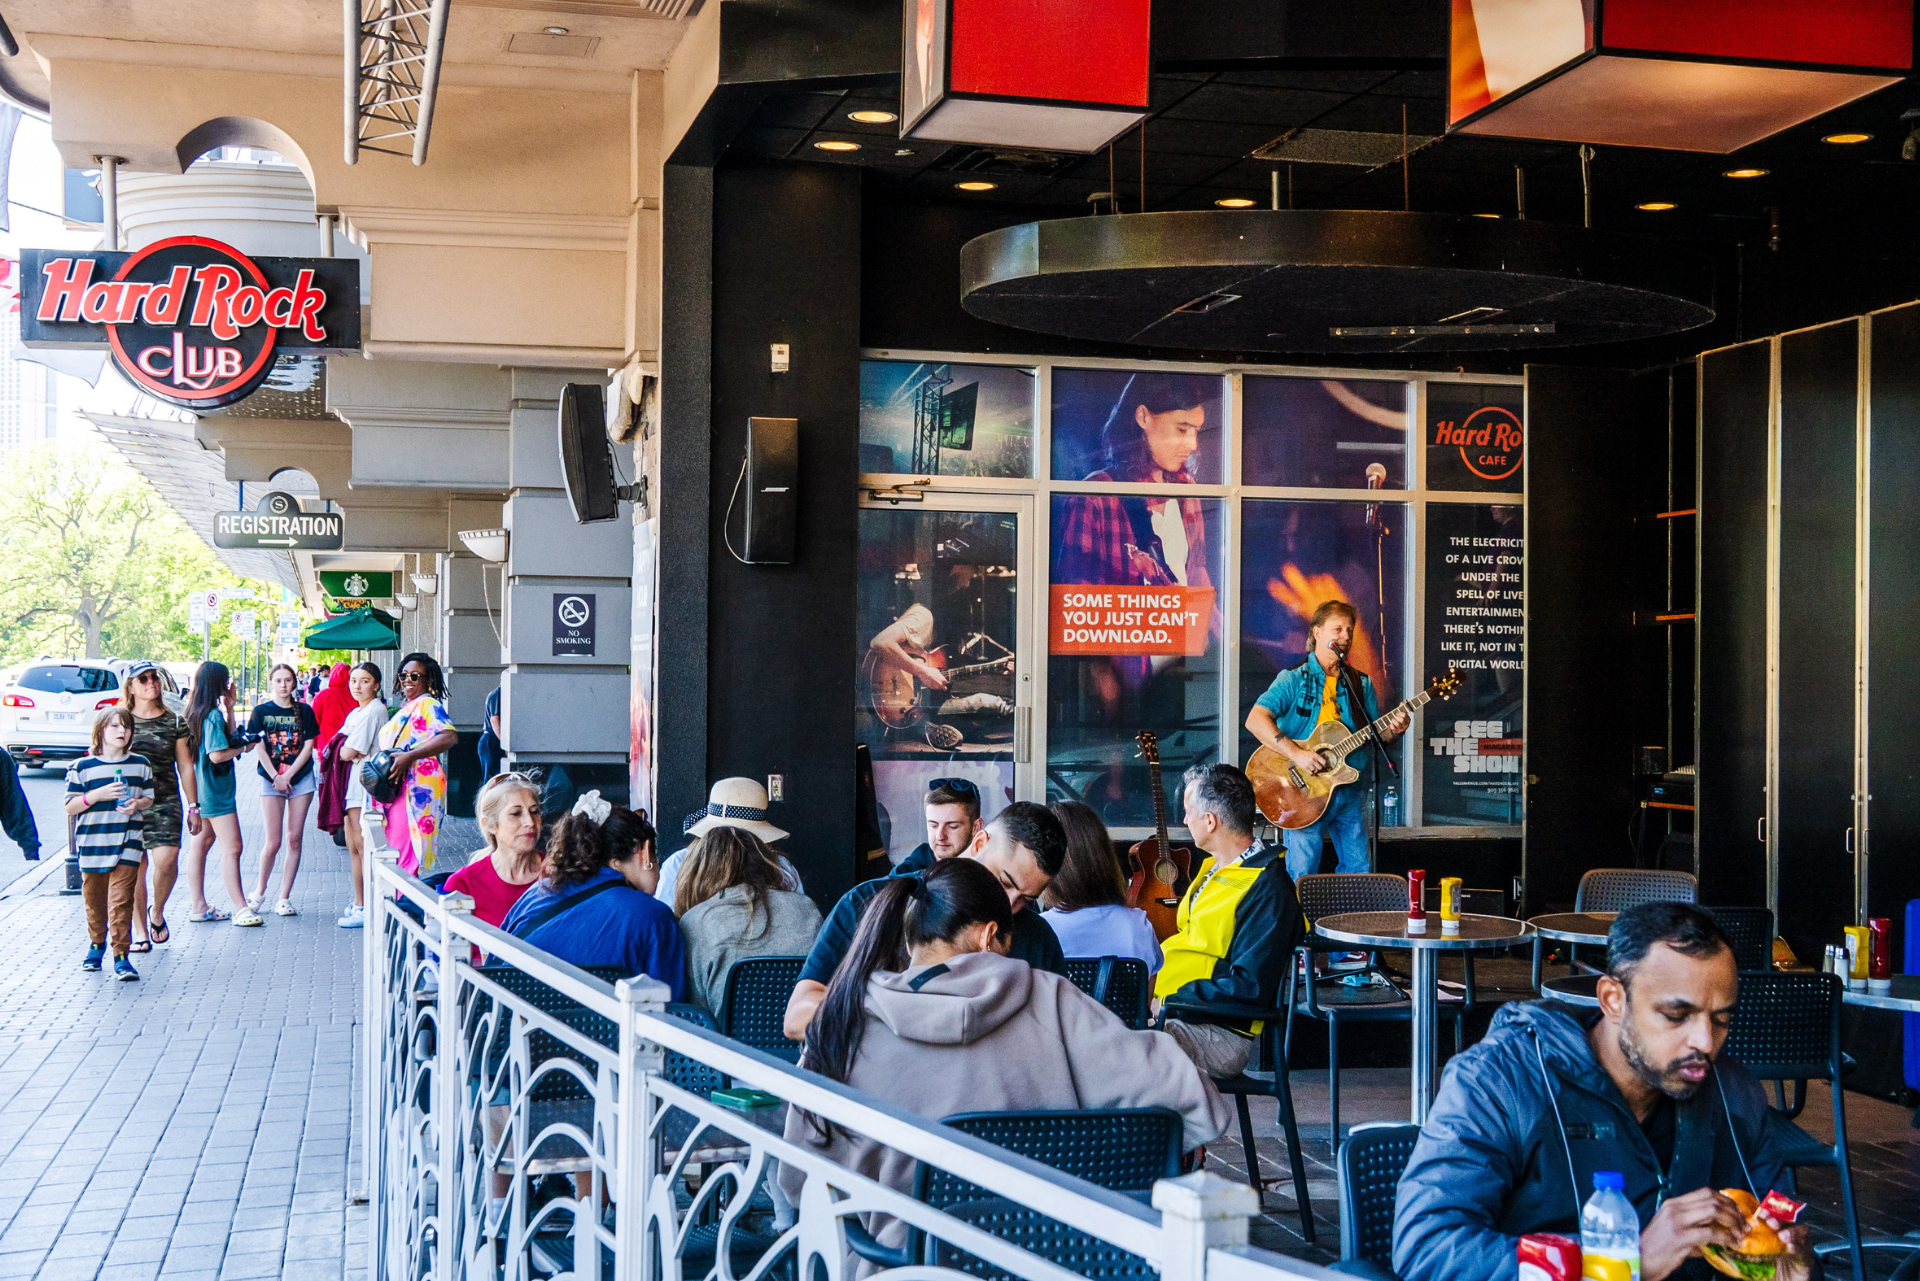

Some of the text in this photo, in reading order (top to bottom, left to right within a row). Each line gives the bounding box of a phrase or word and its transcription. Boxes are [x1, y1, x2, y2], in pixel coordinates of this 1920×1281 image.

[36, 258, 328, 343] Hard Rock
[137, 331, 244, 390] CLUB
[1435, 421, 1493, 446] Hard
[1478, 455, 1507, 466] CAFE
[218, 515, 339, 536] REGISTRATION
[1450, 537, 1470, 546] THE
[1445, 554, 1459, 564] OF
[1461, 555, 1470, 564] A
[1472, 555, 1493, 564] LIVE
[1461, 572, 1520, 582] UNDER THE
[1063, 593, 1181, 608] SOME THINGS
[1456, 589, 1524, 600] SPELL OF LIVE
[1062, 611, 1199, 626] YOU JUST CAN'T
[1443, 622, 1484, 634] THERE'S
[1063, 629, 1172, 643] DOWNLOAD.
[1441, 642, 1462, 651] LIKE
[1465, 642, 1476, 653] IT,
[1479, 642, 1502, 652] NOT
[1504, 643, 1516, 652] IN
[1448, 659, 1487, 669] DIGITAL
[1454, 720, 1503, 738] SEE
[1429, 738, 1479, 755] THE
[1453, 755, 1519, 773] SHOW
